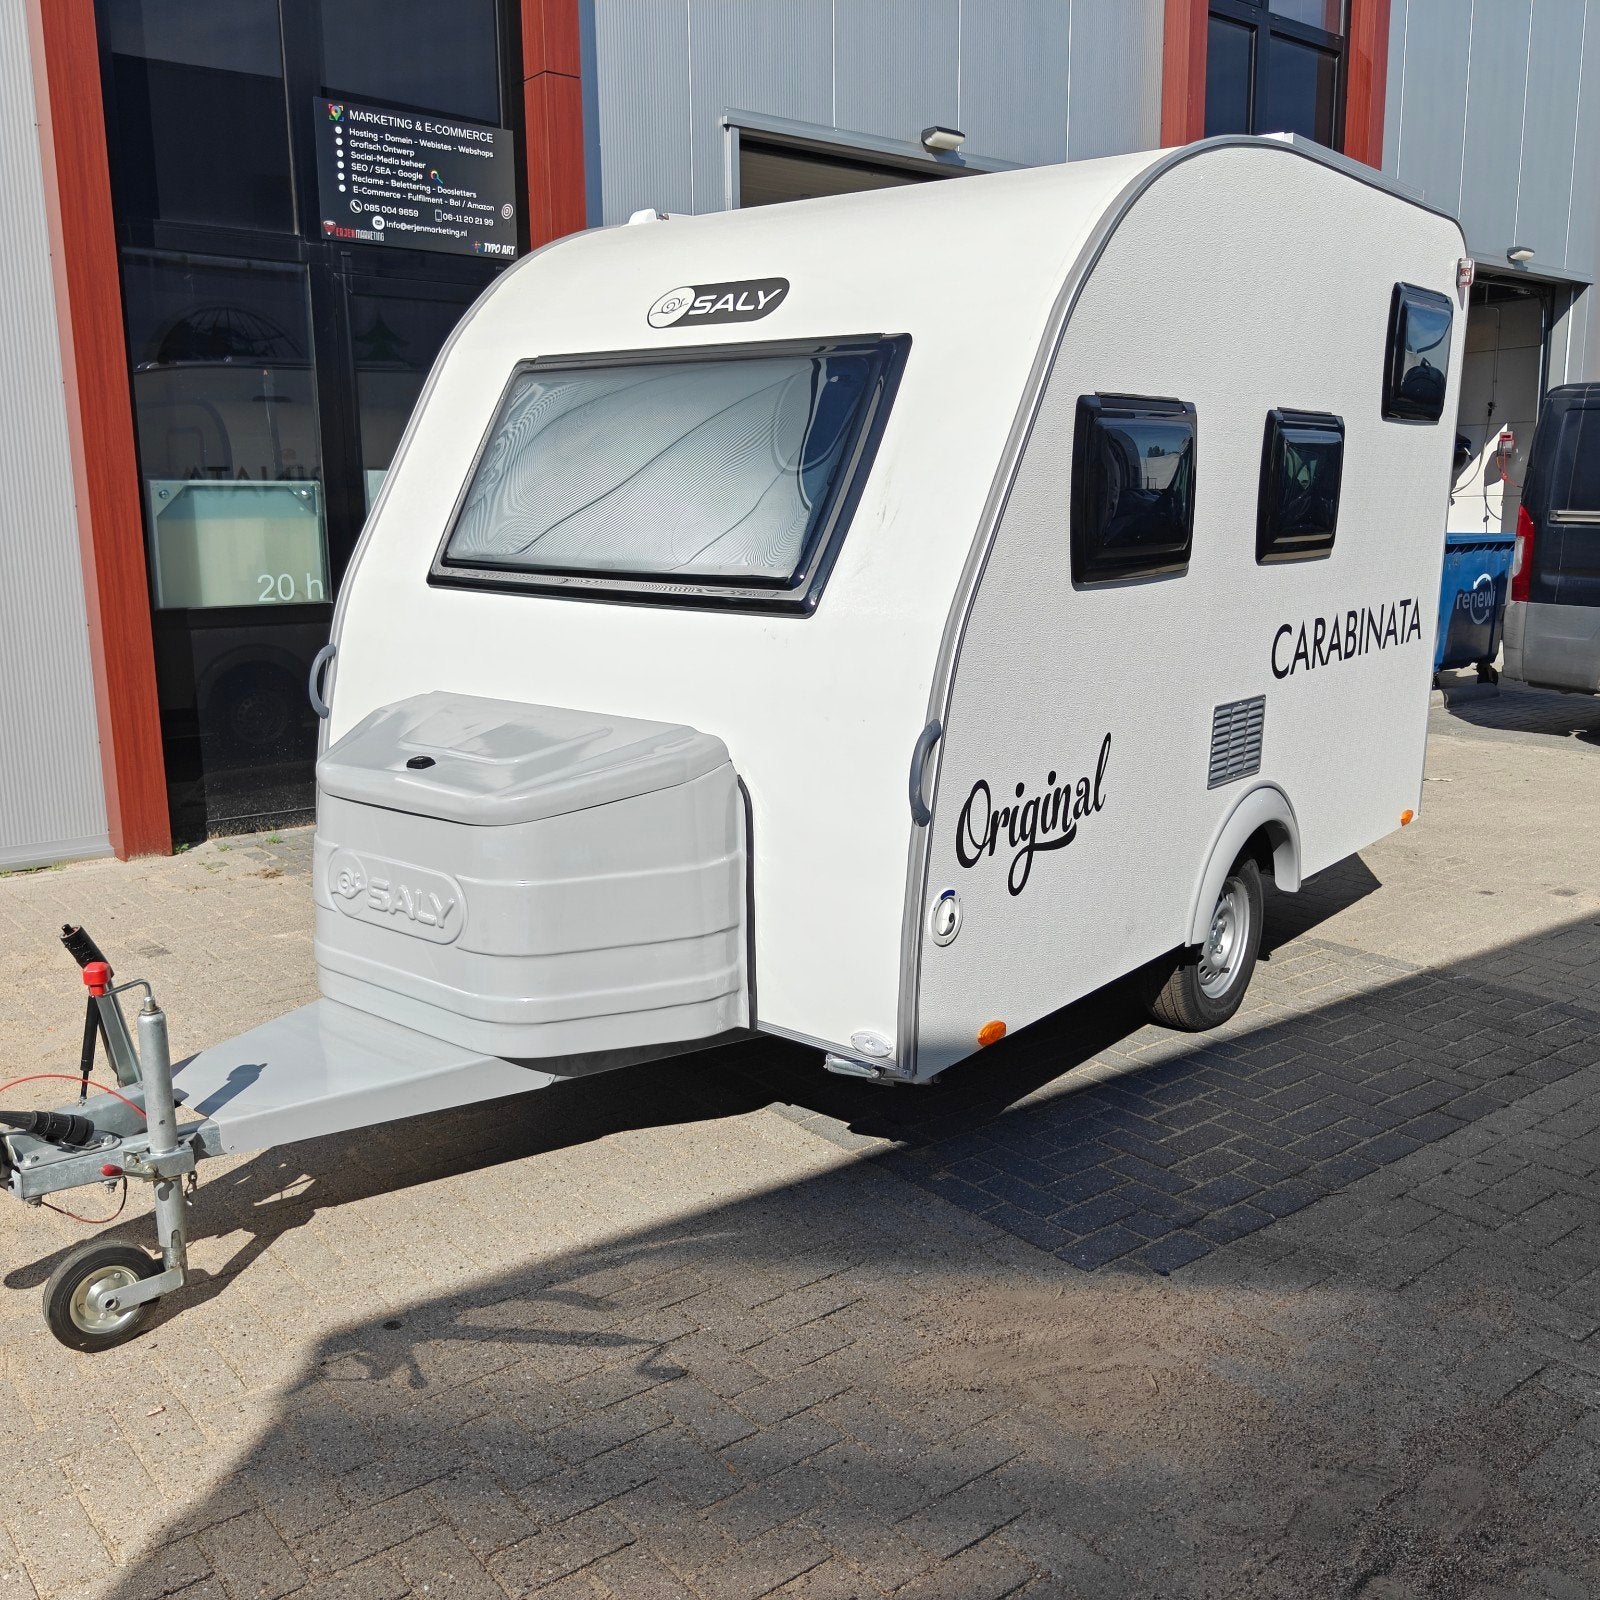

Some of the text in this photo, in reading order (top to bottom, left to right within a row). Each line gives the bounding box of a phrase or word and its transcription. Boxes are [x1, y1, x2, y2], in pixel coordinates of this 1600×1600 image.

[349, 110, 494, 143] MARKETING & E-COMMERCE
[349, 128, 378, 142] Hosting
[458, 145, 494, 159] Webshops
[349, 139, 415, 158] Grafisch Ontwerp
[350, 151, 426, 169] Social-Media beheer
[351, 162, 368, 172] SEO
[374, 165, 392, 176] SEA
[397, 169, 423, 181] Google
[352, 173, 384, 186] Reclame
[390, 179, 431, 195] Belettering
[353, 185, 401, 199] E-Commerce
[449, 198, 461, 207] Bol
[467, 201, 495, 212] Amazon
[363, 203, 380, 213] 085
[381, 205, 397, 215] 004
[463, 216, 474, 224] 20
[483, 242, 515, 256] TYPO ART
[688, 288, 783, 316] SALY
[257, 572, 324, 602] 20 h
[1456, 585, 1496, 610] renewi
[1271, 596, 1421, 679] CARABINATA
[955, 732, 1112, 896] Original
[367, 876, 455, 929] SALY
